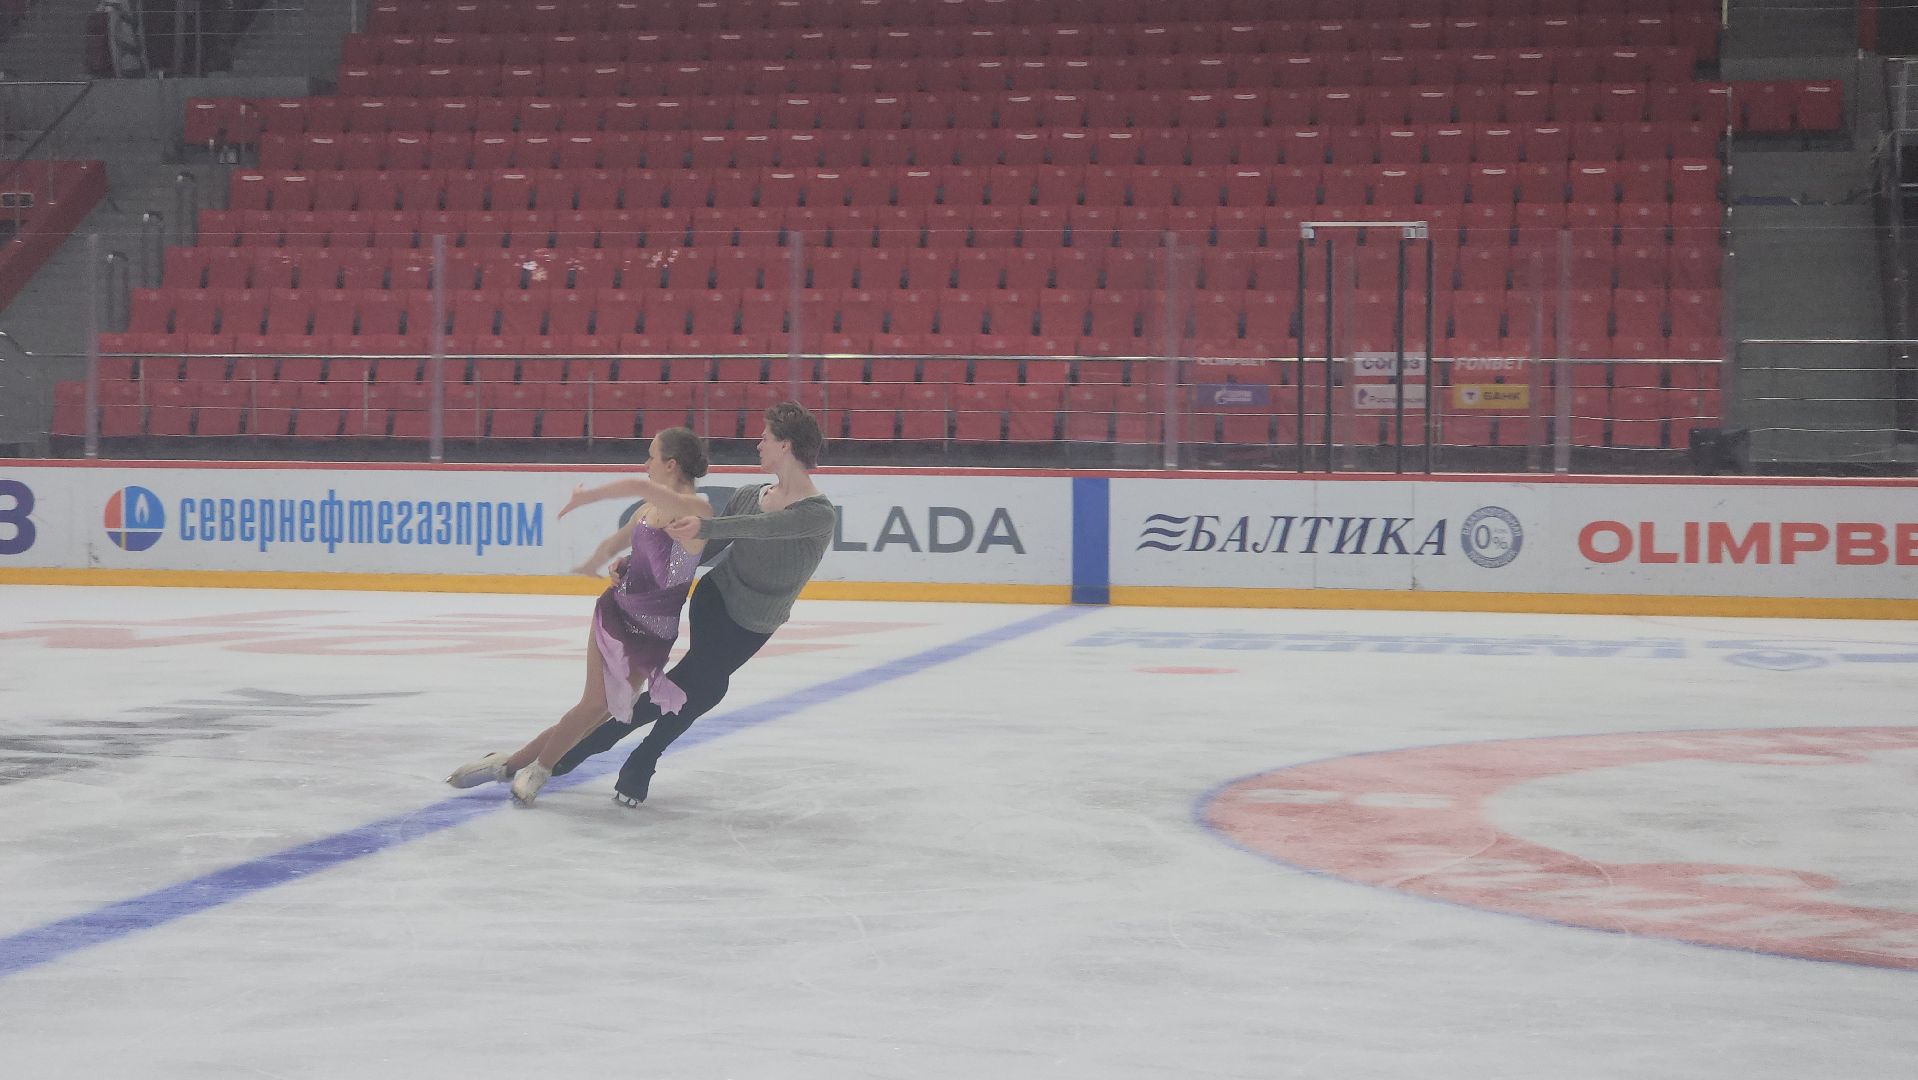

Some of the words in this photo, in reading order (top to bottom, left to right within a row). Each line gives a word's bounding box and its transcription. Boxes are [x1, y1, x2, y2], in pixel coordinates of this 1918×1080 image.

[1454, 357, 1525, 371] FONBET
[1483, 390, 1522, 401] БАНК
[180, 489, 544, 556] севернефтегазпром
[833, 504, 1027, 555] LADA
[1183, 514, 1448, 556] БАЛТИКА
